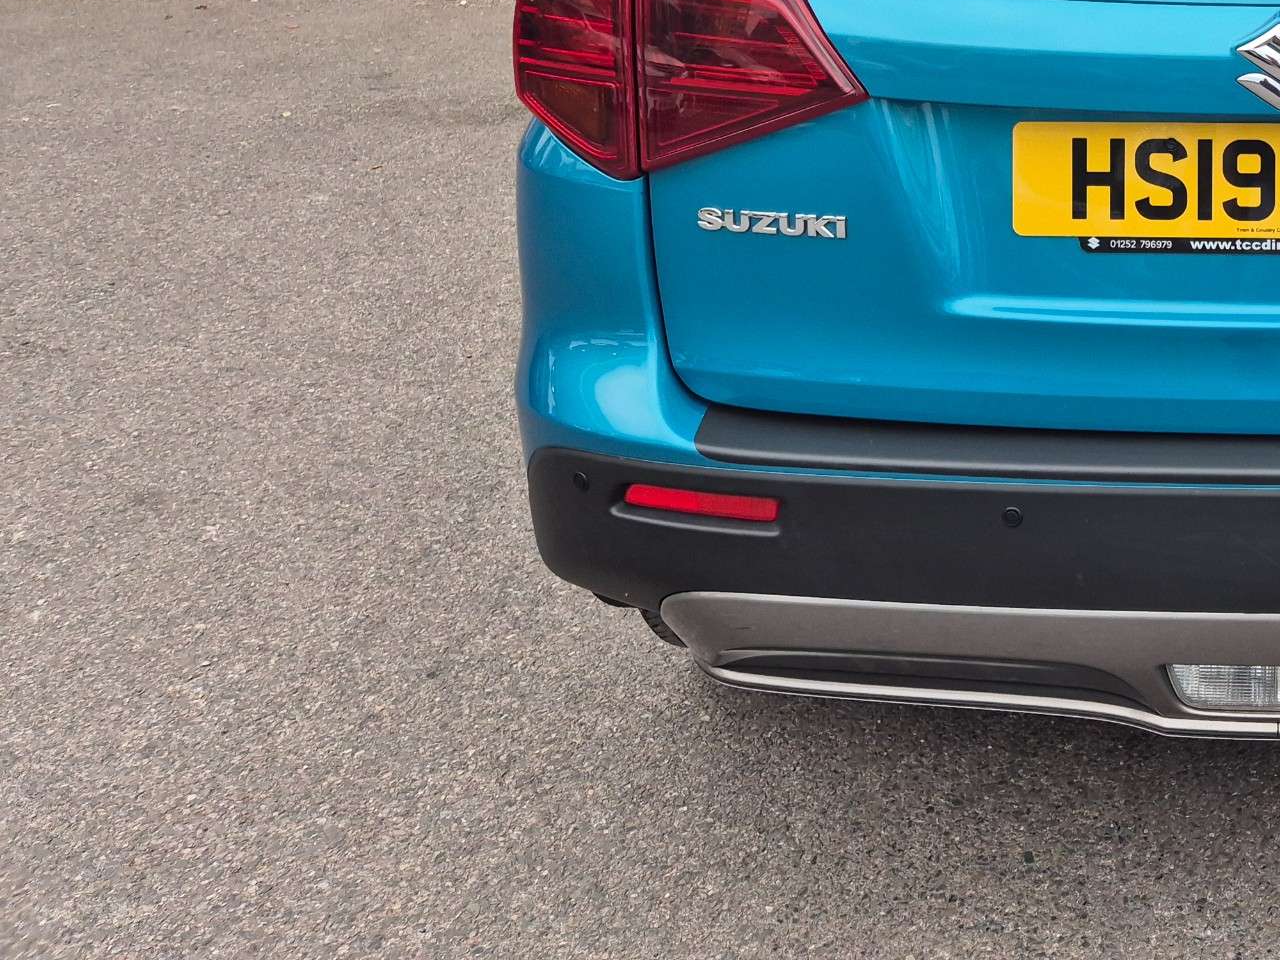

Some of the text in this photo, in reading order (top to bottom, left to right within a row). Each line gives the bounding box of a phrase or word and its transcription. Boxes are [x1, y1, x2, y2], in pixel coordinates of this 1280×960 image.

[1072, 137, 1276, 222] HS19
[697, 206, 846, 239] SUZUKI
[1110, 239, 1136, 249] 01252
[1140, 239, 1173, 249] 796979
